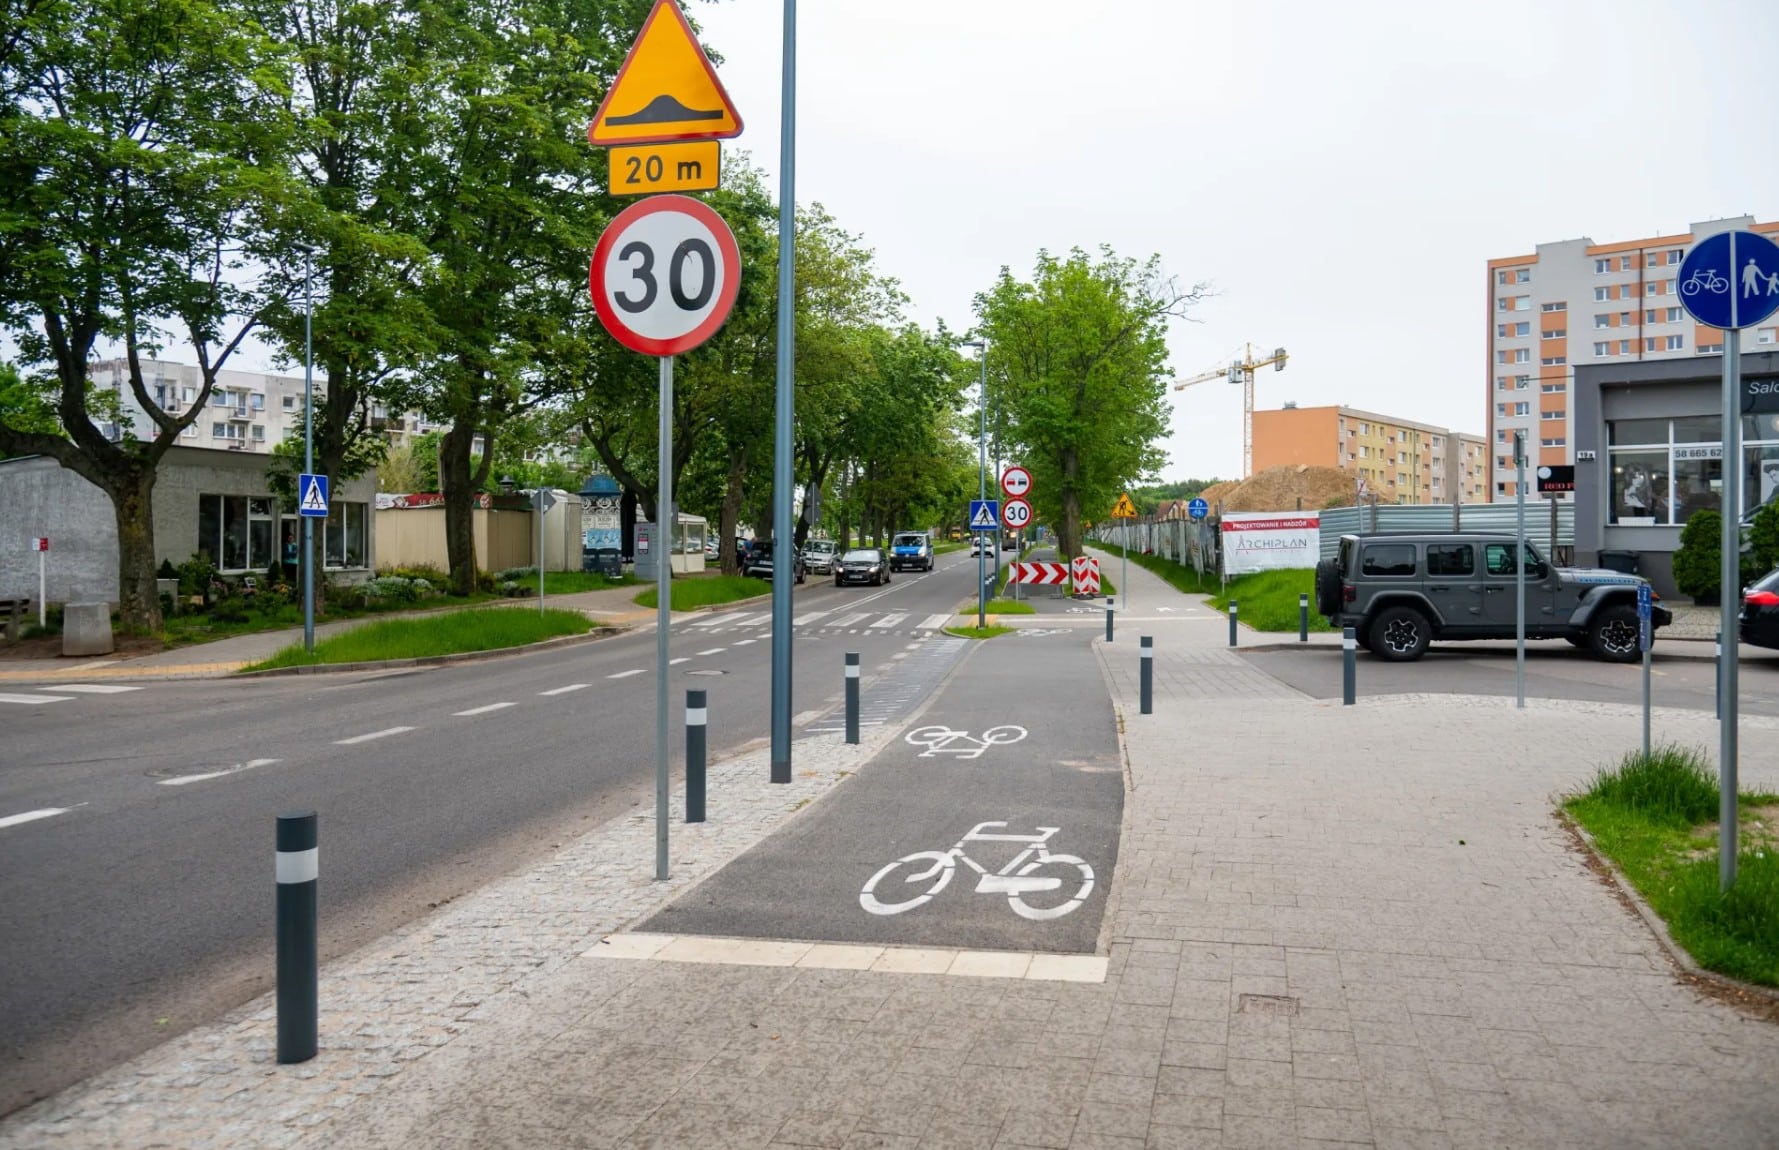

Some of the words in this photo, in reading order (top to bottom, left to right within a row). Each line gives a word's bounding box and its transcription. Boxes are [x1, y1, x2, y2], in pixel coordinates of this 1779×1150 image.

[626, 155, 663, 184] 20
[677, 160, 702, 181] m
[614, 238, 716, 314] 30
[1675, 449, 1687, 458] 58
[1690, 449, 1707, 458] 665
[1007, 506, 1028, 521] 30
[1232, 521, 1279, 529] PROJEKTOWANIE
[1236, 535, 1307, 550] ARCHIPLAN
